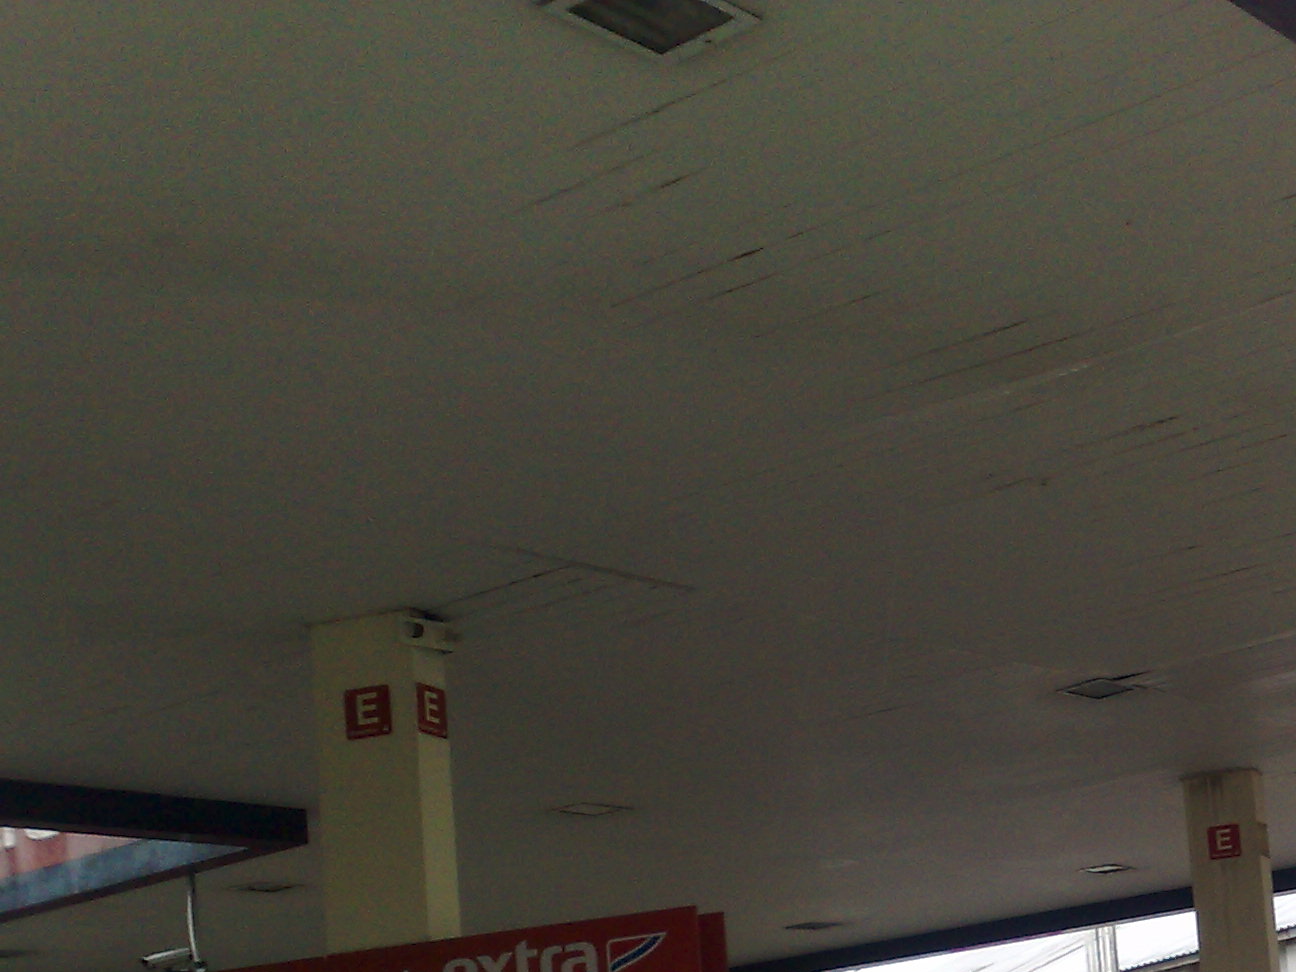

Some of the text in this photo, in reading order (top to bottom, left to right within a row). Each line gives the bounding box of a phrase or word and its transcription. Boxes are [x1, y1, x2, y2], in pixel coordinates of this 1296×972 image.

[356, 692, 379, 725] E
[423, 691, 441, 724] E
[1215, 828, 1234, 851] E
